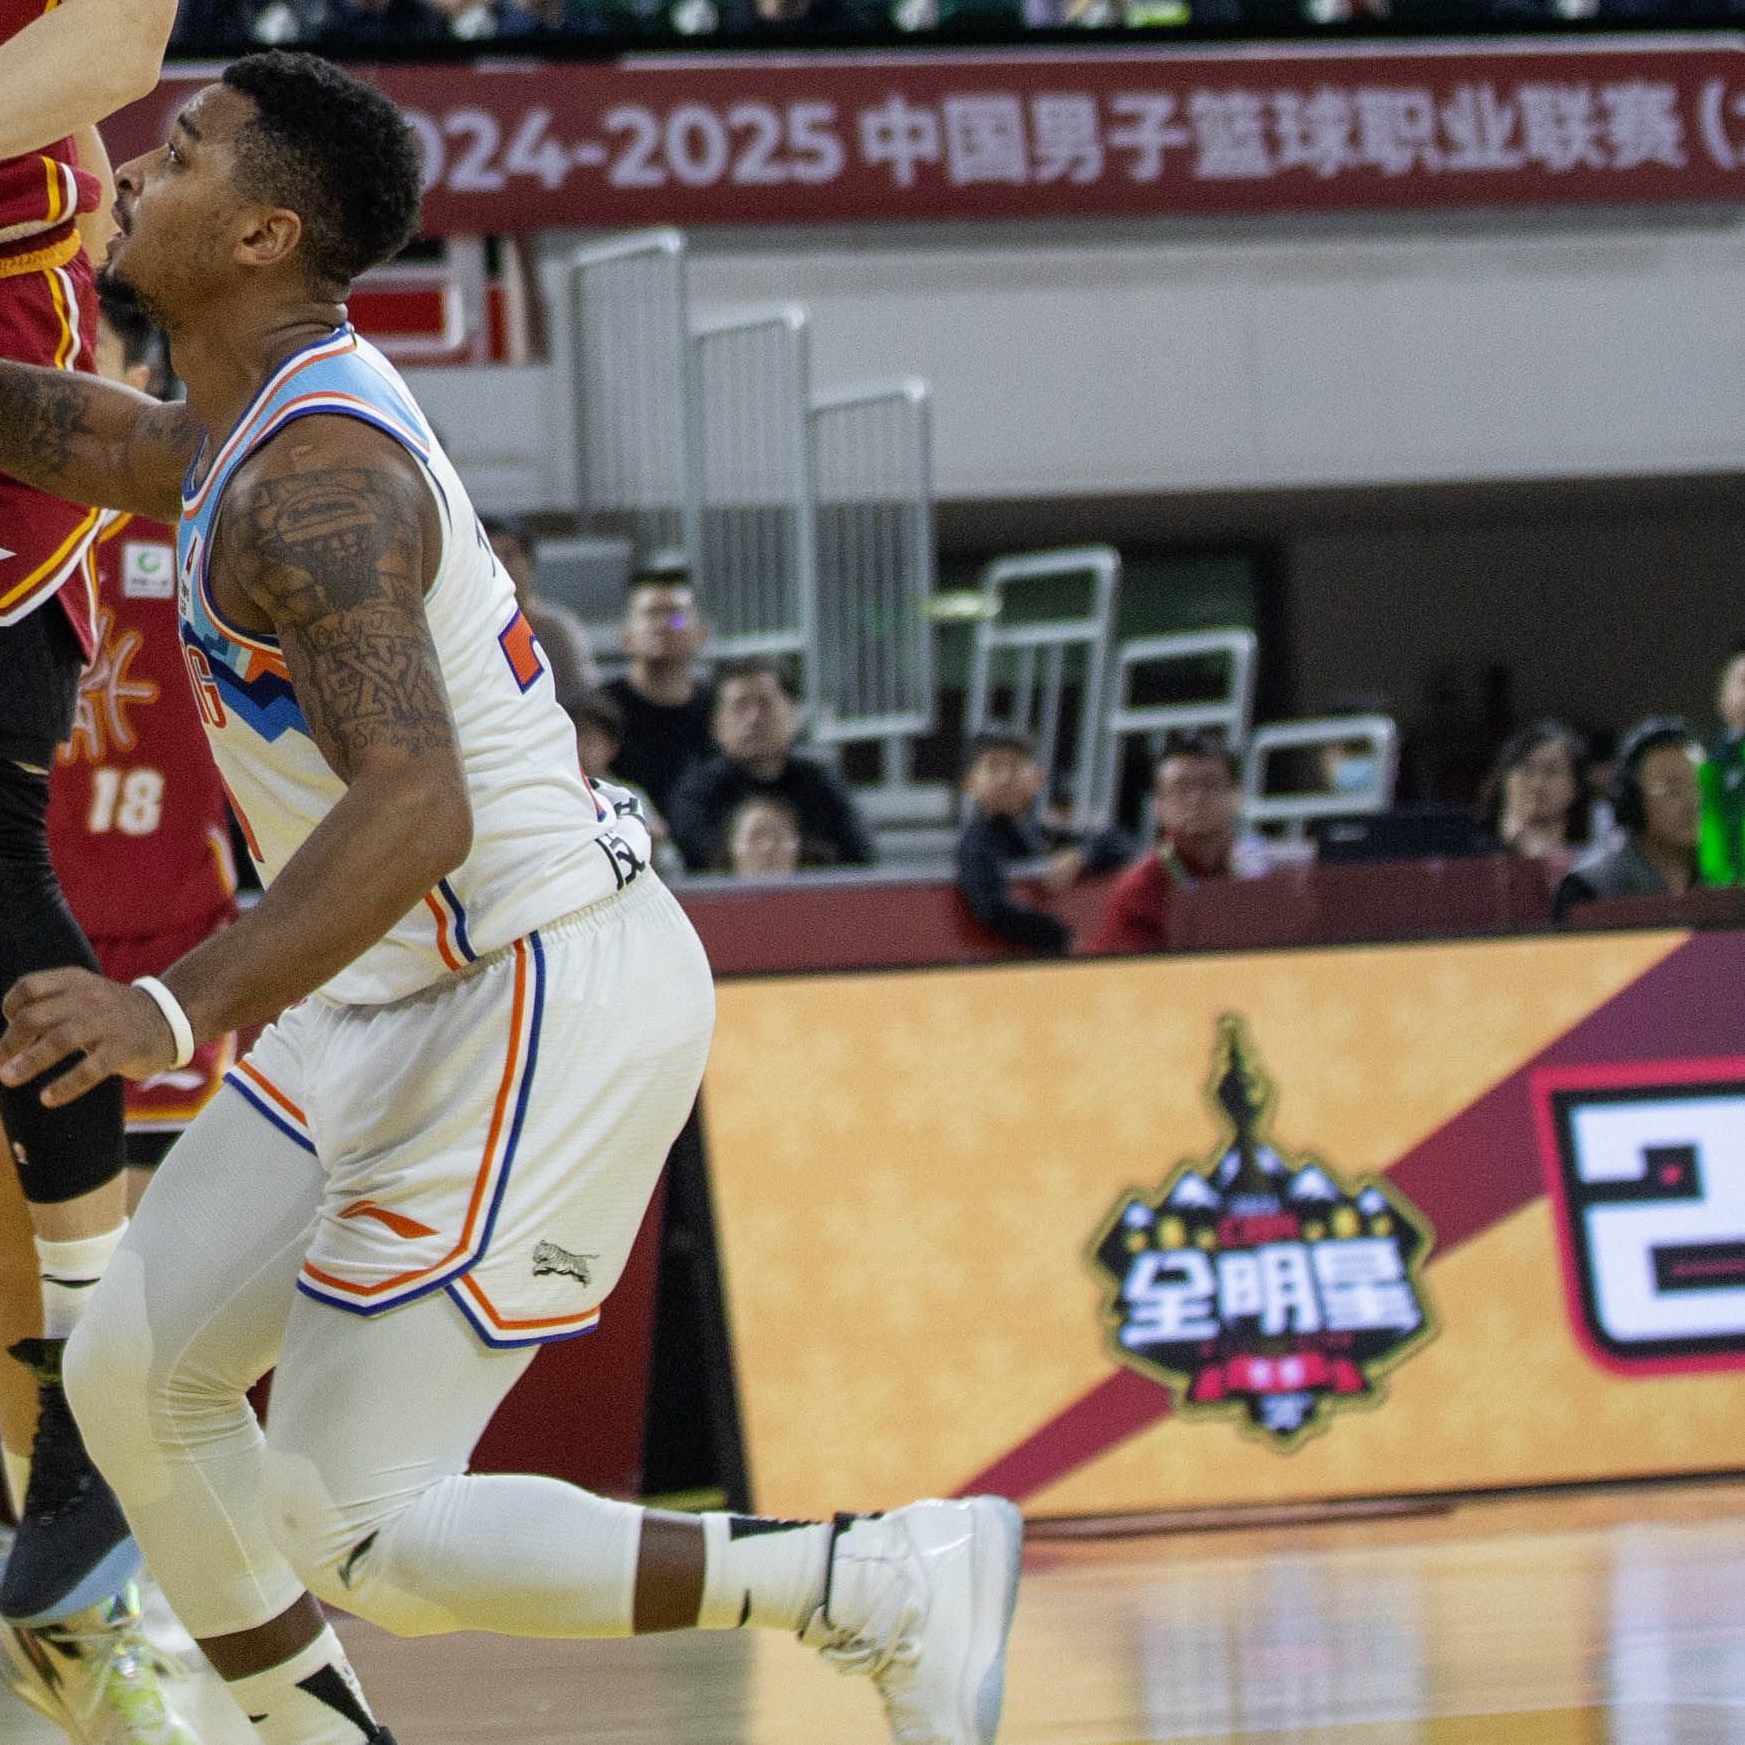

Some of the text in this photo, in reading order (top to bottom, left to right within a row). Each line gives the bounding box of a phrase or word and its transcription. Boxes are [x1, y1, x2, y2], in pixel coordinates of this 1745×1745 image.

[88, 766, 165, 837] 18
[1117, 1235, 1422, 1349] 全明星
